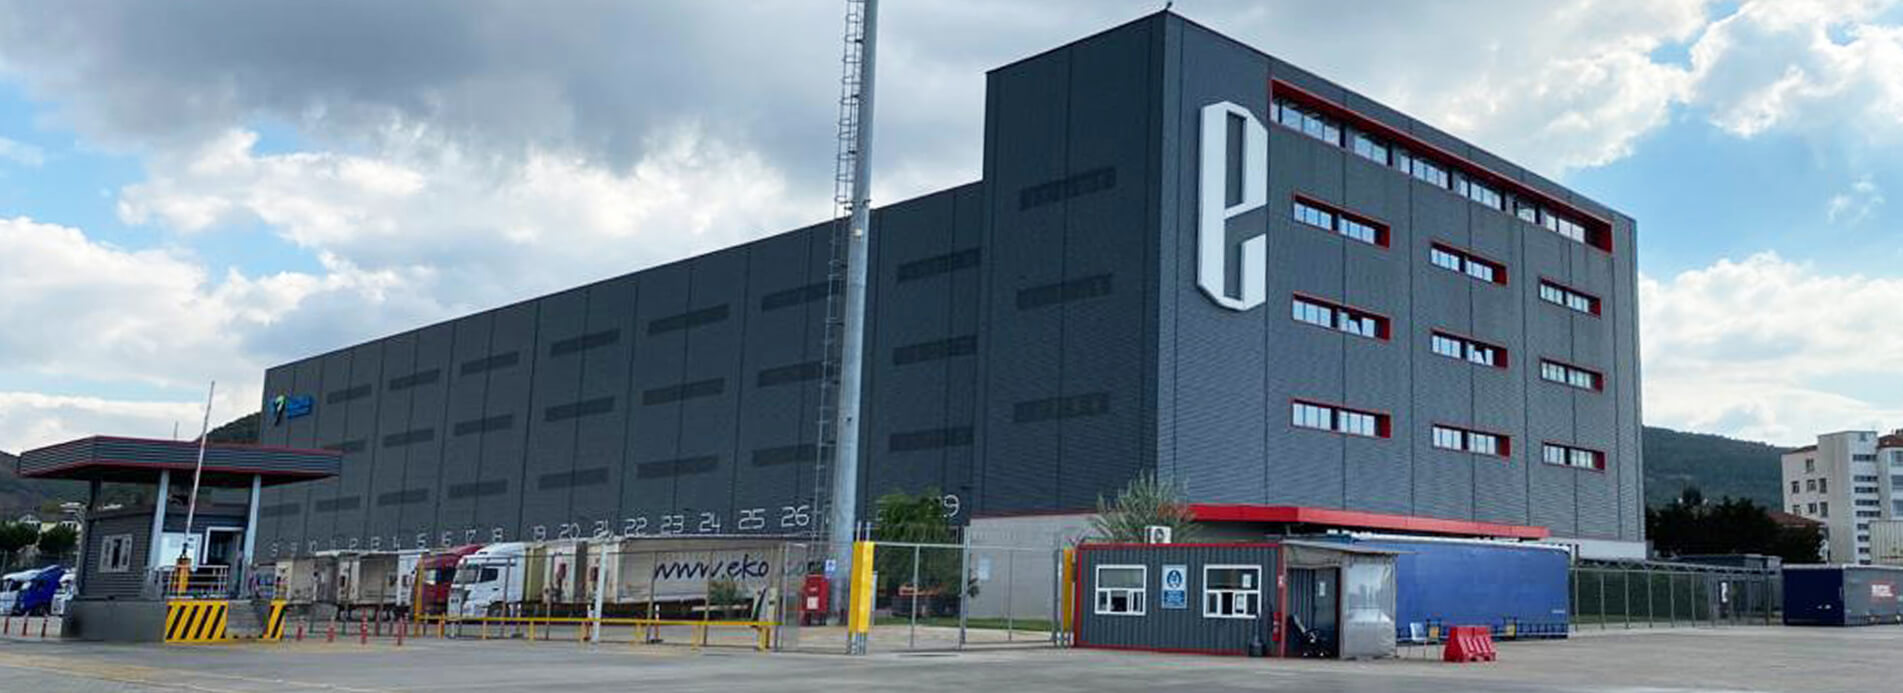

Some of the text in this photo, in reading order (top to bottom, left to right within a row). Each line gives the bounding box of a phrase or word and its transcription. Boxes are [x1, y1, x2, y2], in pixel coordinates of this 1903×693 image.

[560, 522, 580, 540] 20
[624, 517, 648, 538] 22
[660, 515, 684, 536] 23
[700, 511, 721, 533] 24
[738, 508, 766, 530] 25
[780, 504, 810, 527] 26
